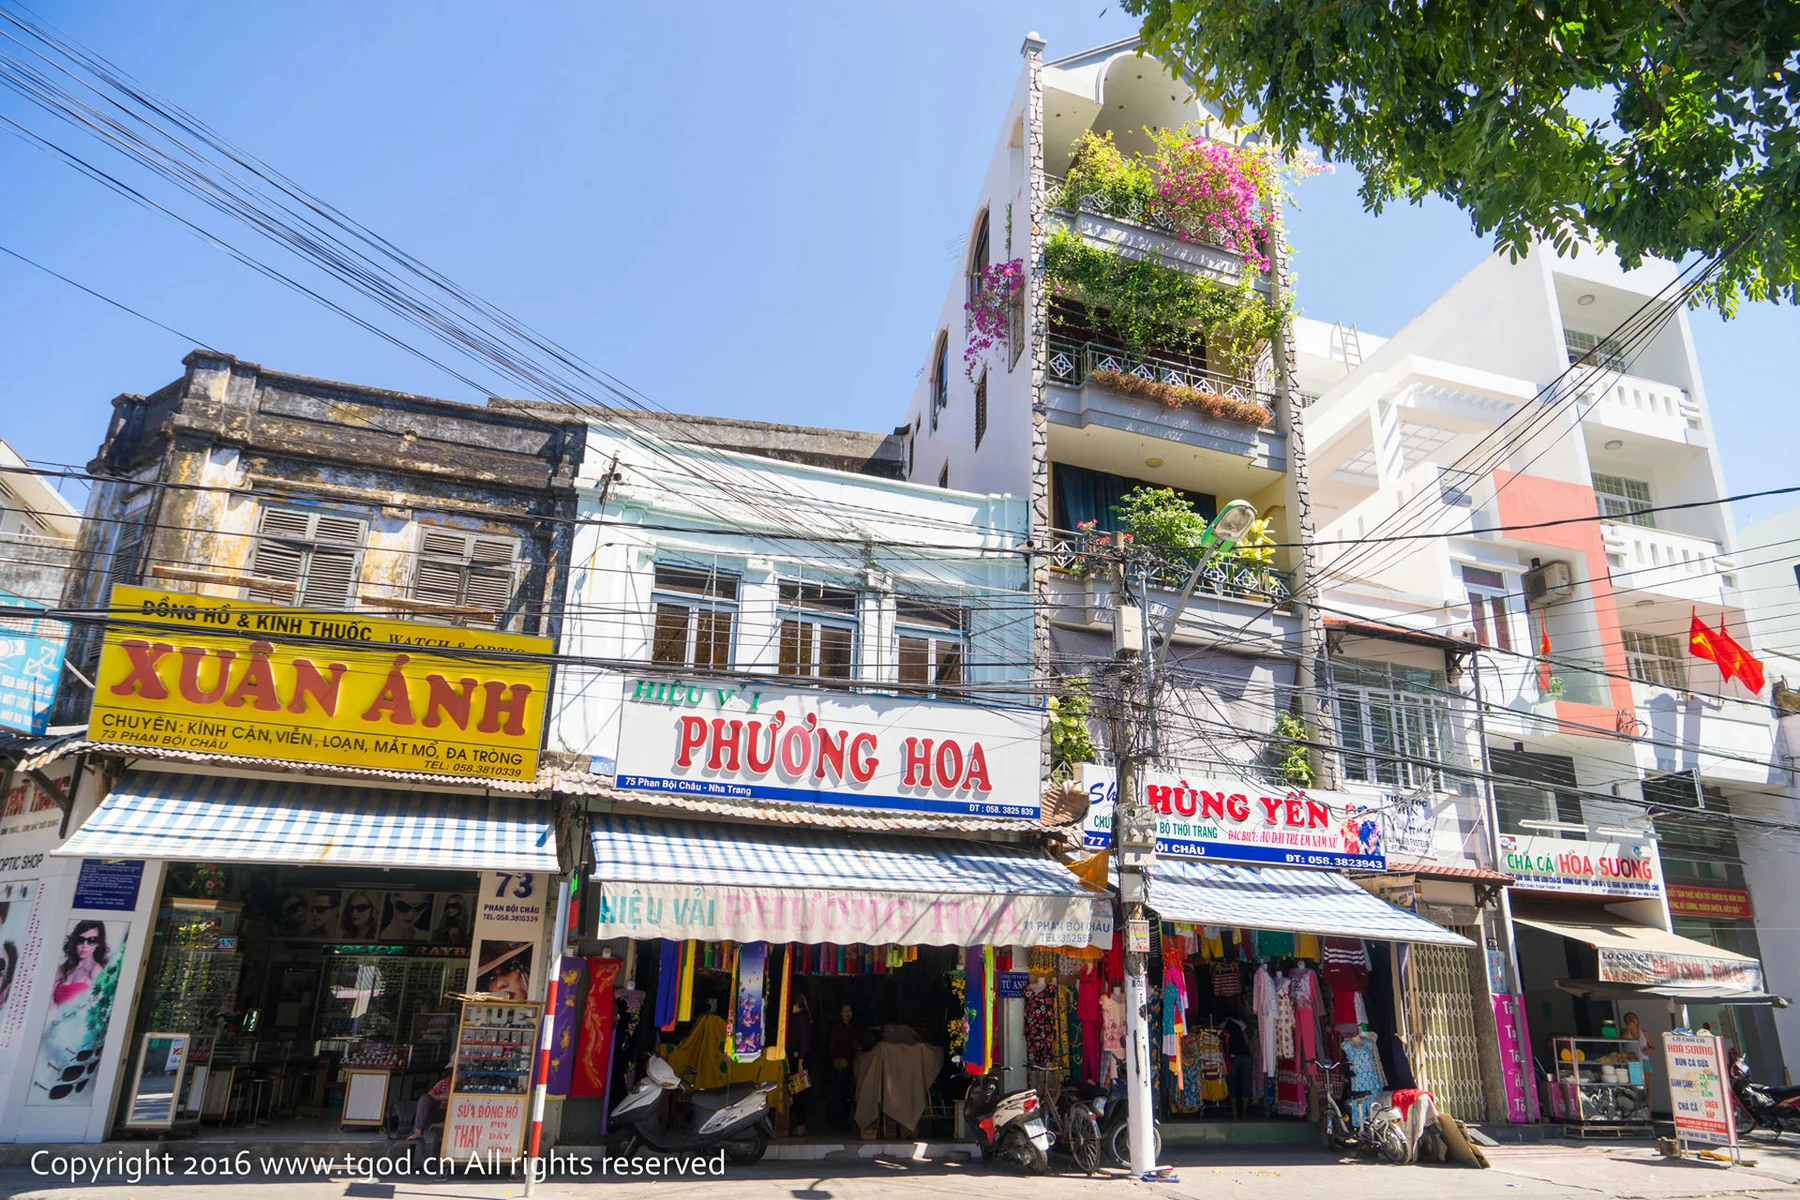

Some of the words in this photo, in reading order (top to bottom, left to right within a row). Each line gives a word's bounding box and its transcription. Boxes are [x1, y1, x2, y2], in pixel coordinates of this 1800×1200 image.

[142, 596, 197, 621] ĐỒNG
[203, 603, 231, 625] HỒ
[237, 614, 250, 628] &
[256, 612, 302, 634] KÍNH
[310, 619, 373, 642] THUỐC
[110, 639, 348, 718] XUÂN
[361, 653, 533, 737] ÁNH
[632, 679, 707, 706] HIỆU
[101, 729, 116, 739] 73
[120, 731, 159, 744] PHAN
[162, 734, 186, 747] BỘI
[189, 736, 229, 750] CHÂU
[187, 719, 227, 737] KÍNH
[232, 725, 272, 744] CẬN,
[323, 735, 367, 754] LOẠN,
[446, 746, 467, 761] ĐA
[473, 748, 523, 766] TRÒNG
[677, 710, 880, 784] PHƯƠNG
[902, 736, 993, 793] HOA
[424, 759, 450, 771] TEL:
[453, 763, 522, 778] 058.3810339
[625, 777, 636, 786] 75
[638, 777, 660, 788] Phan
[662, 779, 677, 790] Bội
[679, 780, 701, 791] Châu
[708, 783, 725, 793] Nha
[727, 785, 752, 797] Trang
[1002, 806, 1020, 816] 3825
[1021, 807, 1034, 816] 839
[1089, 781, 1116, 805] Sh
[1147, 779, 1251, 822] HÙNG
[1260, 791, 1330, 829] YẾN
[1193, 824, 1218, 839] TRANG
[1089, 836, 1105, 846] 77
[1171, 843, 1206, 855] CHÂU
[1286, 854, 1306, 864] ĐT:
[1308, 855, 1383, 869] 058.3823943
[1536, 852, 1555, 873] CÁ
[1559, 850, 1595, 876] HÒA
[495, 872, 533, 898] 73
[484, 903, 505, 912] PHAN
[506, 903, 519, 913] BỘI
[520, 904, 540, 914] CHÂU
[599, 888, 662, 931] HIỆU
[673, 888, 714, 927] VẢI
[723, 891, 915, 934] PHƯƠNG
[930, 899, 1021, 935] HOA
[1037, 921, 1063, 932] PHAN
[477, 1098, 503, 1119] ĐỒNG
[505, 1099, 520, 1119] HỒ
[490, 1120, 508, 1129] PIN
[453, 1124, 484, 1149] THAY
